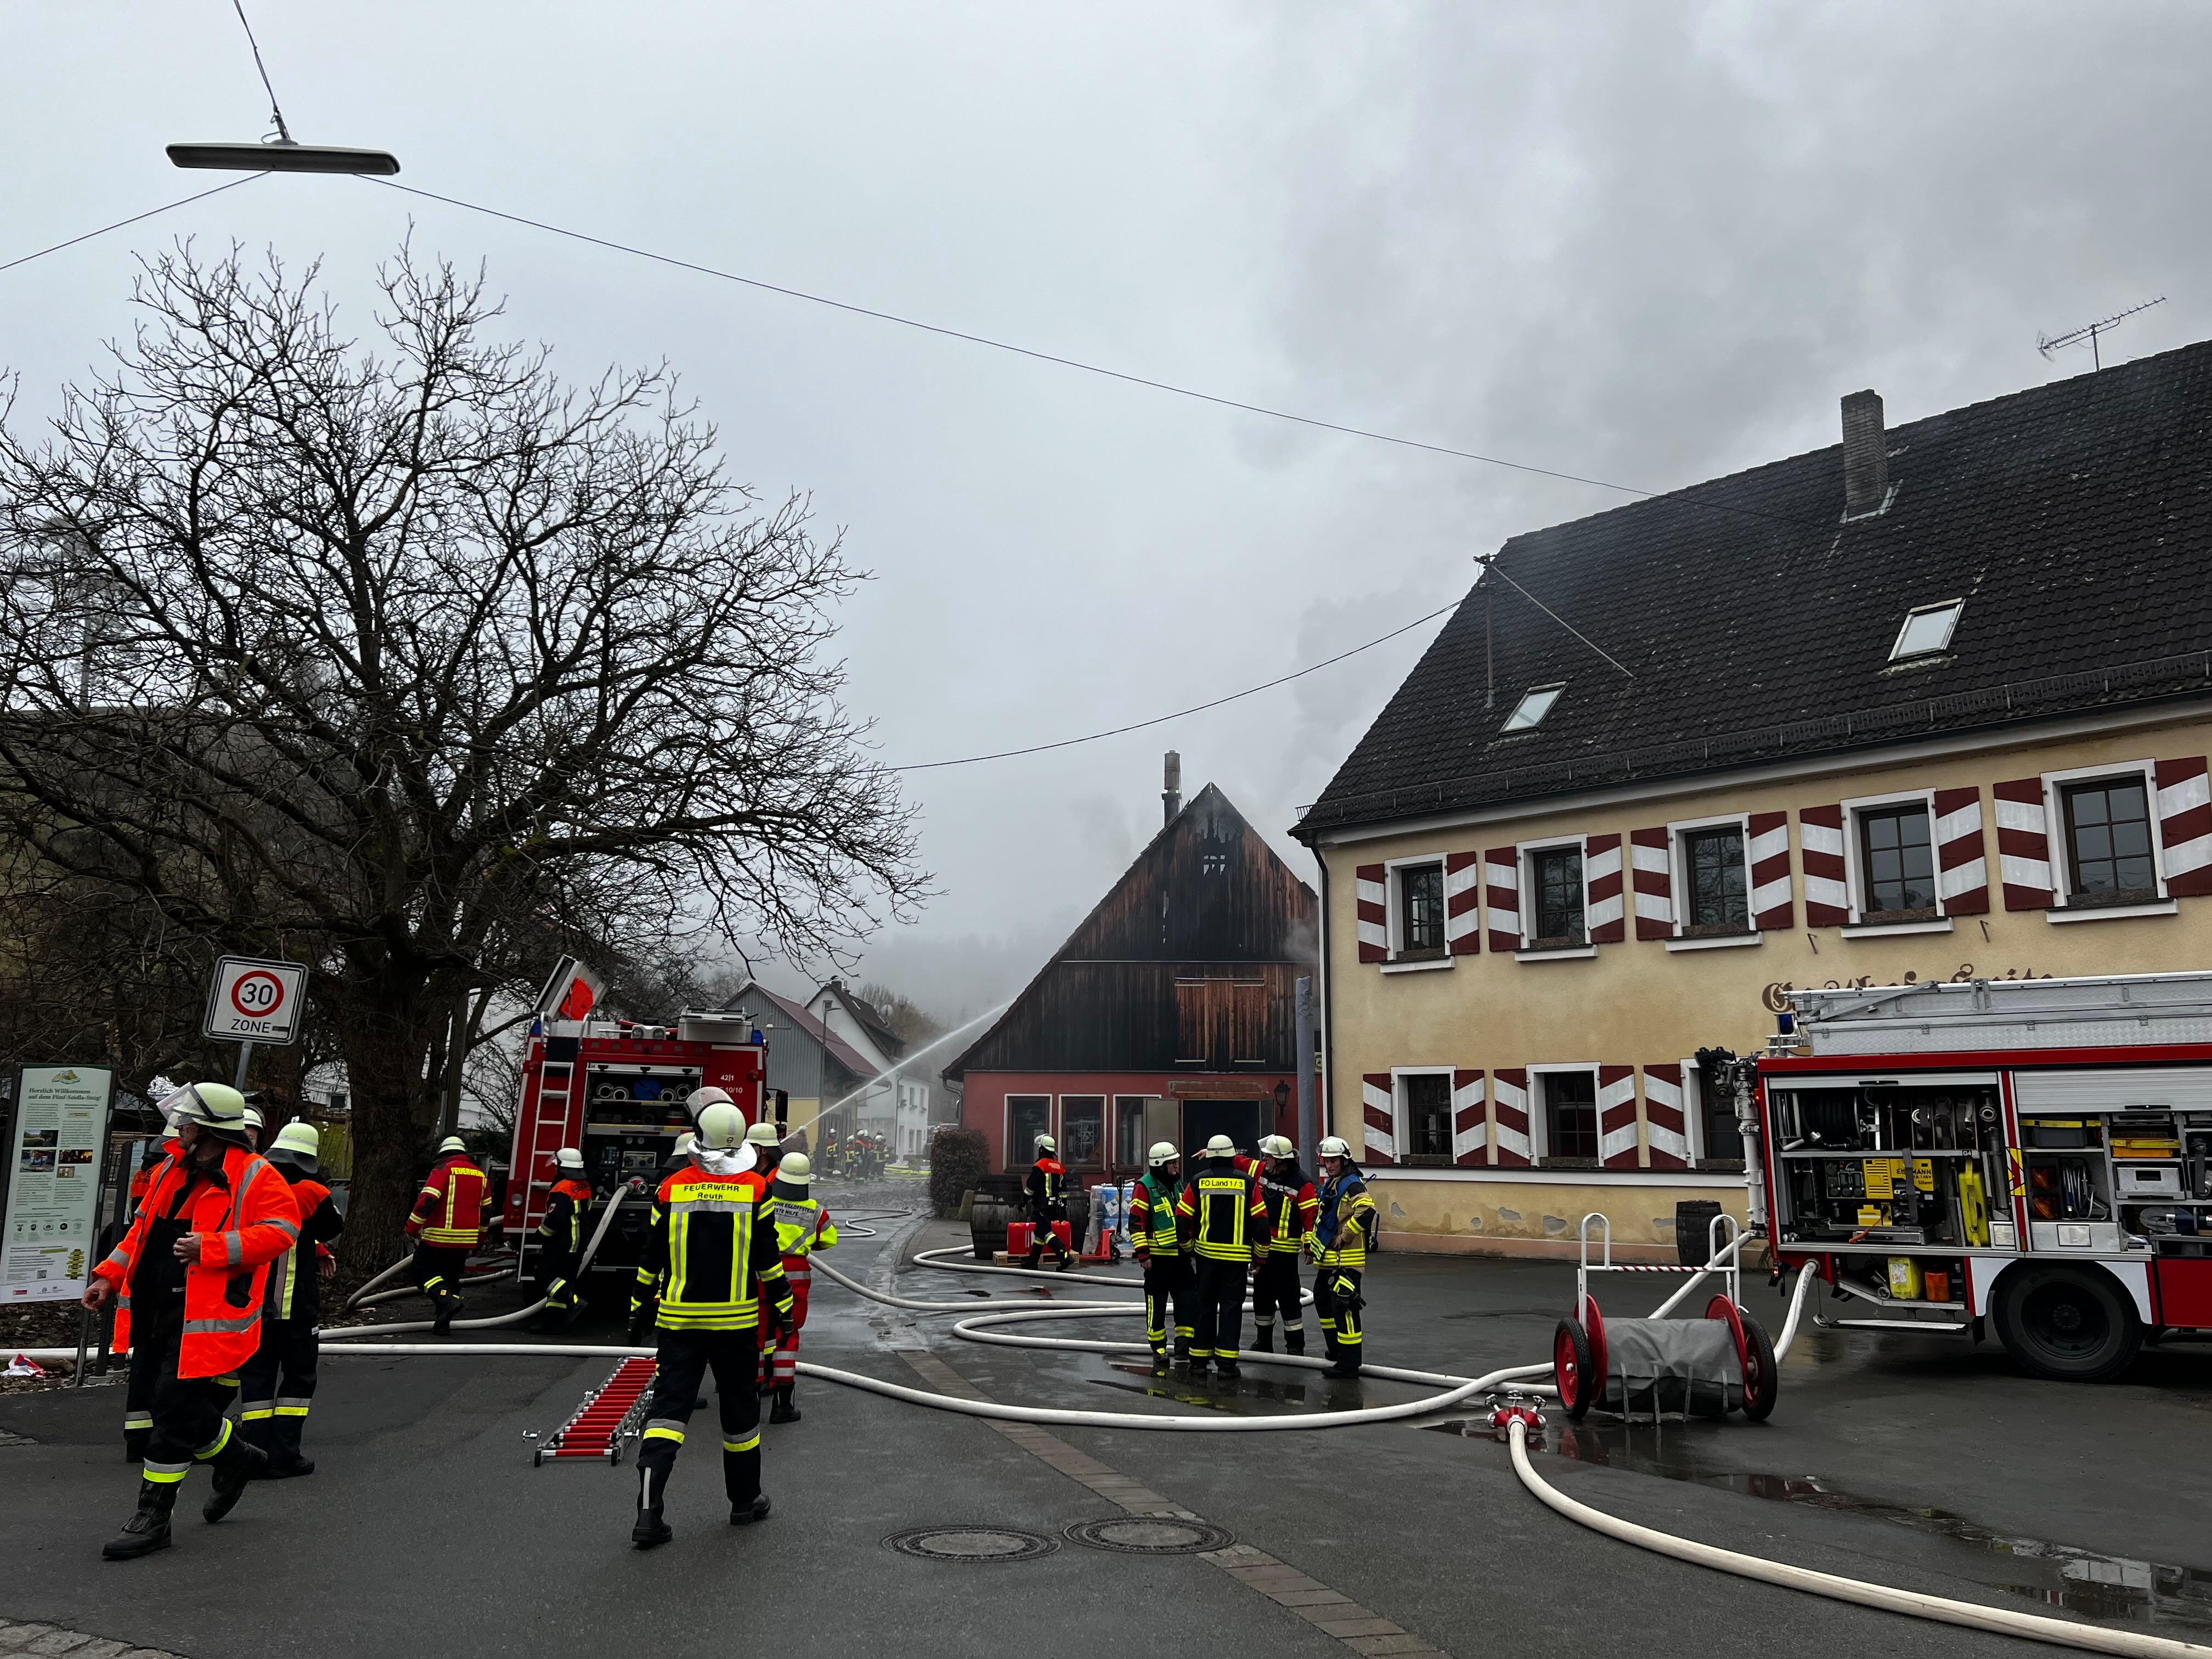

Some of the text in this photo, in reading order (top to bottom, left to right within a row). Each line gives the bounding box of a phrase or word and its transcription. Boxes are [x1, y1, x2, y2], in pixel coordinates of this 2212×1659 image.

[241, 983, 273, 1006] 30
[230, 1019, 272, 1034] ZONE
[684, 1183, 740, 1192] FEUERWEHR
[785, 1203, 815, 1214] EGLOFFSTEIN
